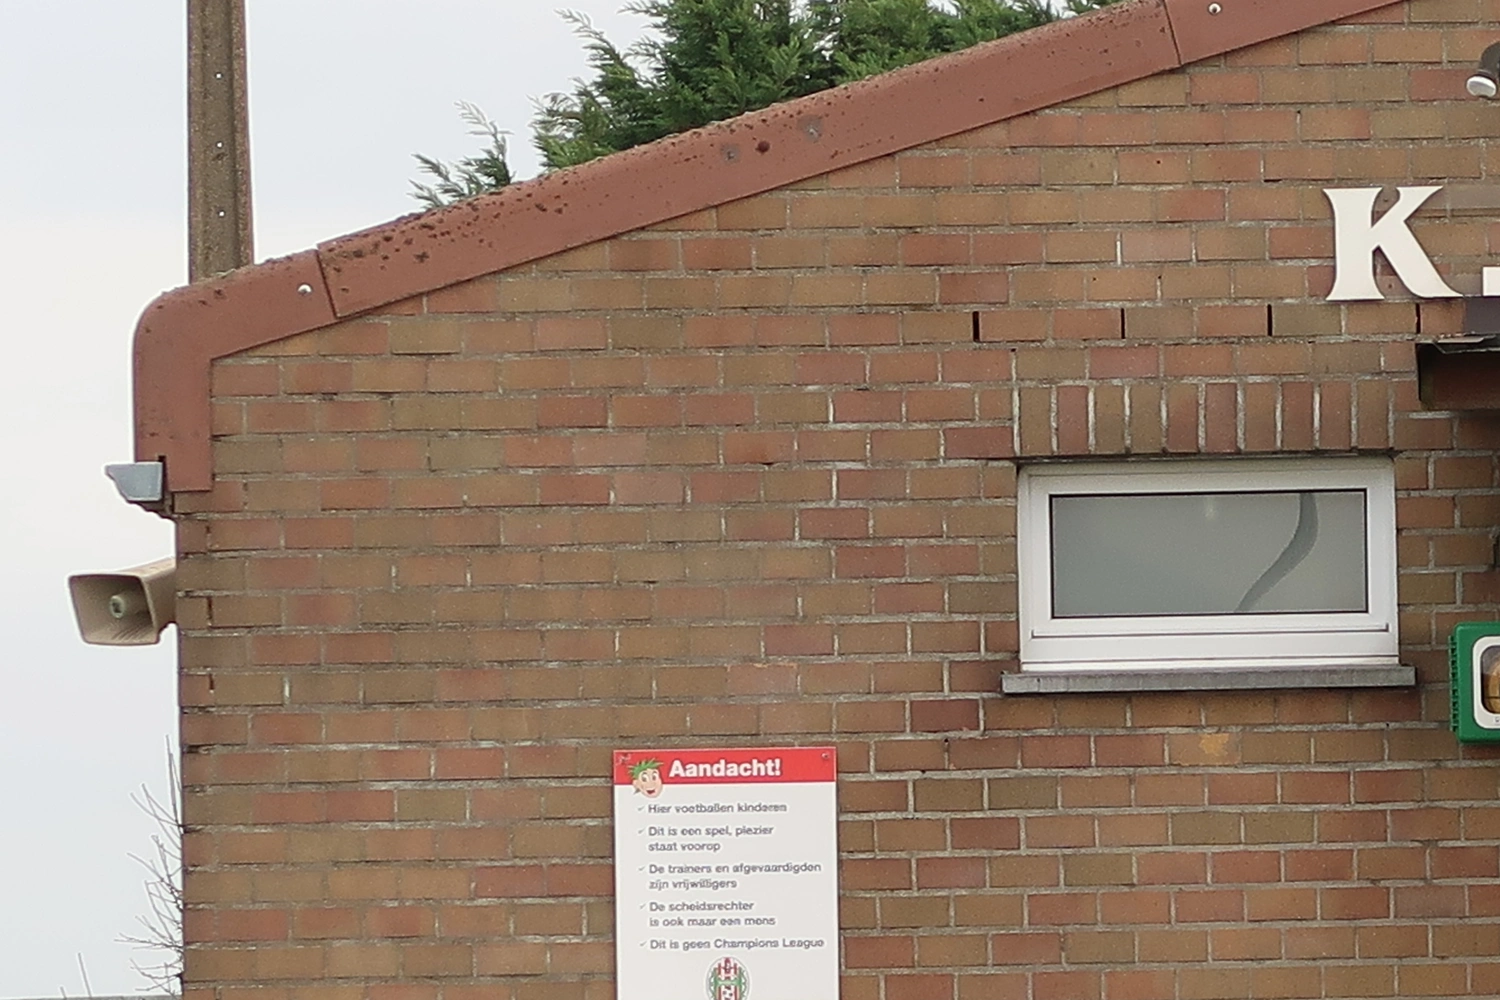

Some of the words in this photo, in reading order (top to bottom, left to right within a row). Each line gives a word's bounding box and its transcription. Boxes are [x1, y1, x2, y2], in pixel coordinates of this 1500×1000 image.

[669, 758, 782, 778] Aandacht!
[648, 803, 672, 814] Hier
[675, 801, 734, 813] voetballen
[737, 800, 788, 812] kinderen
[648, 826, 665, 837] Dit
[668, 825, 678, 836] is
[680, 825, 702, 836] een
[704, 825, 732, 837] spel,
[735, 823, 774, 836] plezier
[648, 841, 678, 852] staat
[681, 840, 721, 852] voorop
[649, 864, 666, 874] De
[668, 862, 712, 874] trainers
[715, 862, 730, 873] en
[732, 859, 822, 874] afgevaardigden
[648, 879, 669, 891] zijn
[672, 877, 737, 891] vrijwilligers
[650, 901, 666, 912] De
[668, 899, 755, 912] scheidsrechter
[649, 917, 660, 927] is
[662, 915, 684, 927] ook
[687, 916, 717, 926] maar
[719, 915, 742, 926] een
[744, 914, 776, 926] mens
[650, 939, 667, 950] Dit
[669, 938, 680, 949] is
[682, 939, 711, 952] geen
[713, 937, 780, 949] Champions
[782, 936, 825, 949] League
